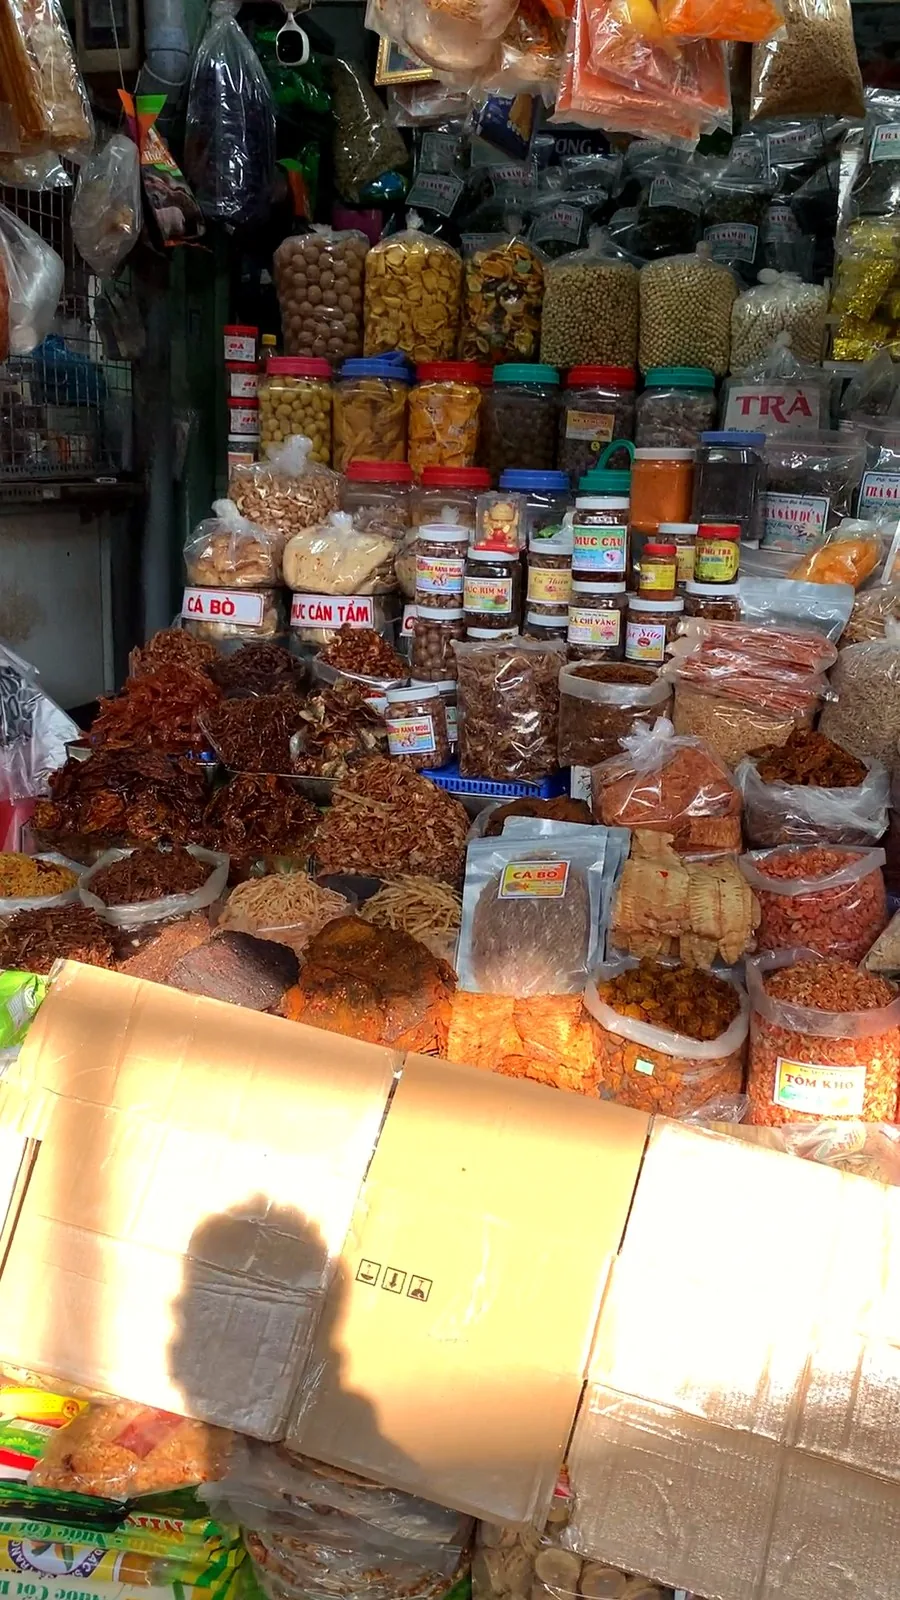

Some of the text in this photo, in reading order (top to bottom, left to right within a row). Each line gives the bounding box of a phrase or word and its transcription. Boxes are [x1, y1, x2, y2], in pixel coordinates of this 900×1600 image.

[736, 389, 812, 423] TRÀ
[187, 595, 236, 616] CÁ BÒ
[308, 602, 332, 621] CÁN
[337, 600, 369, 622] TẨM
